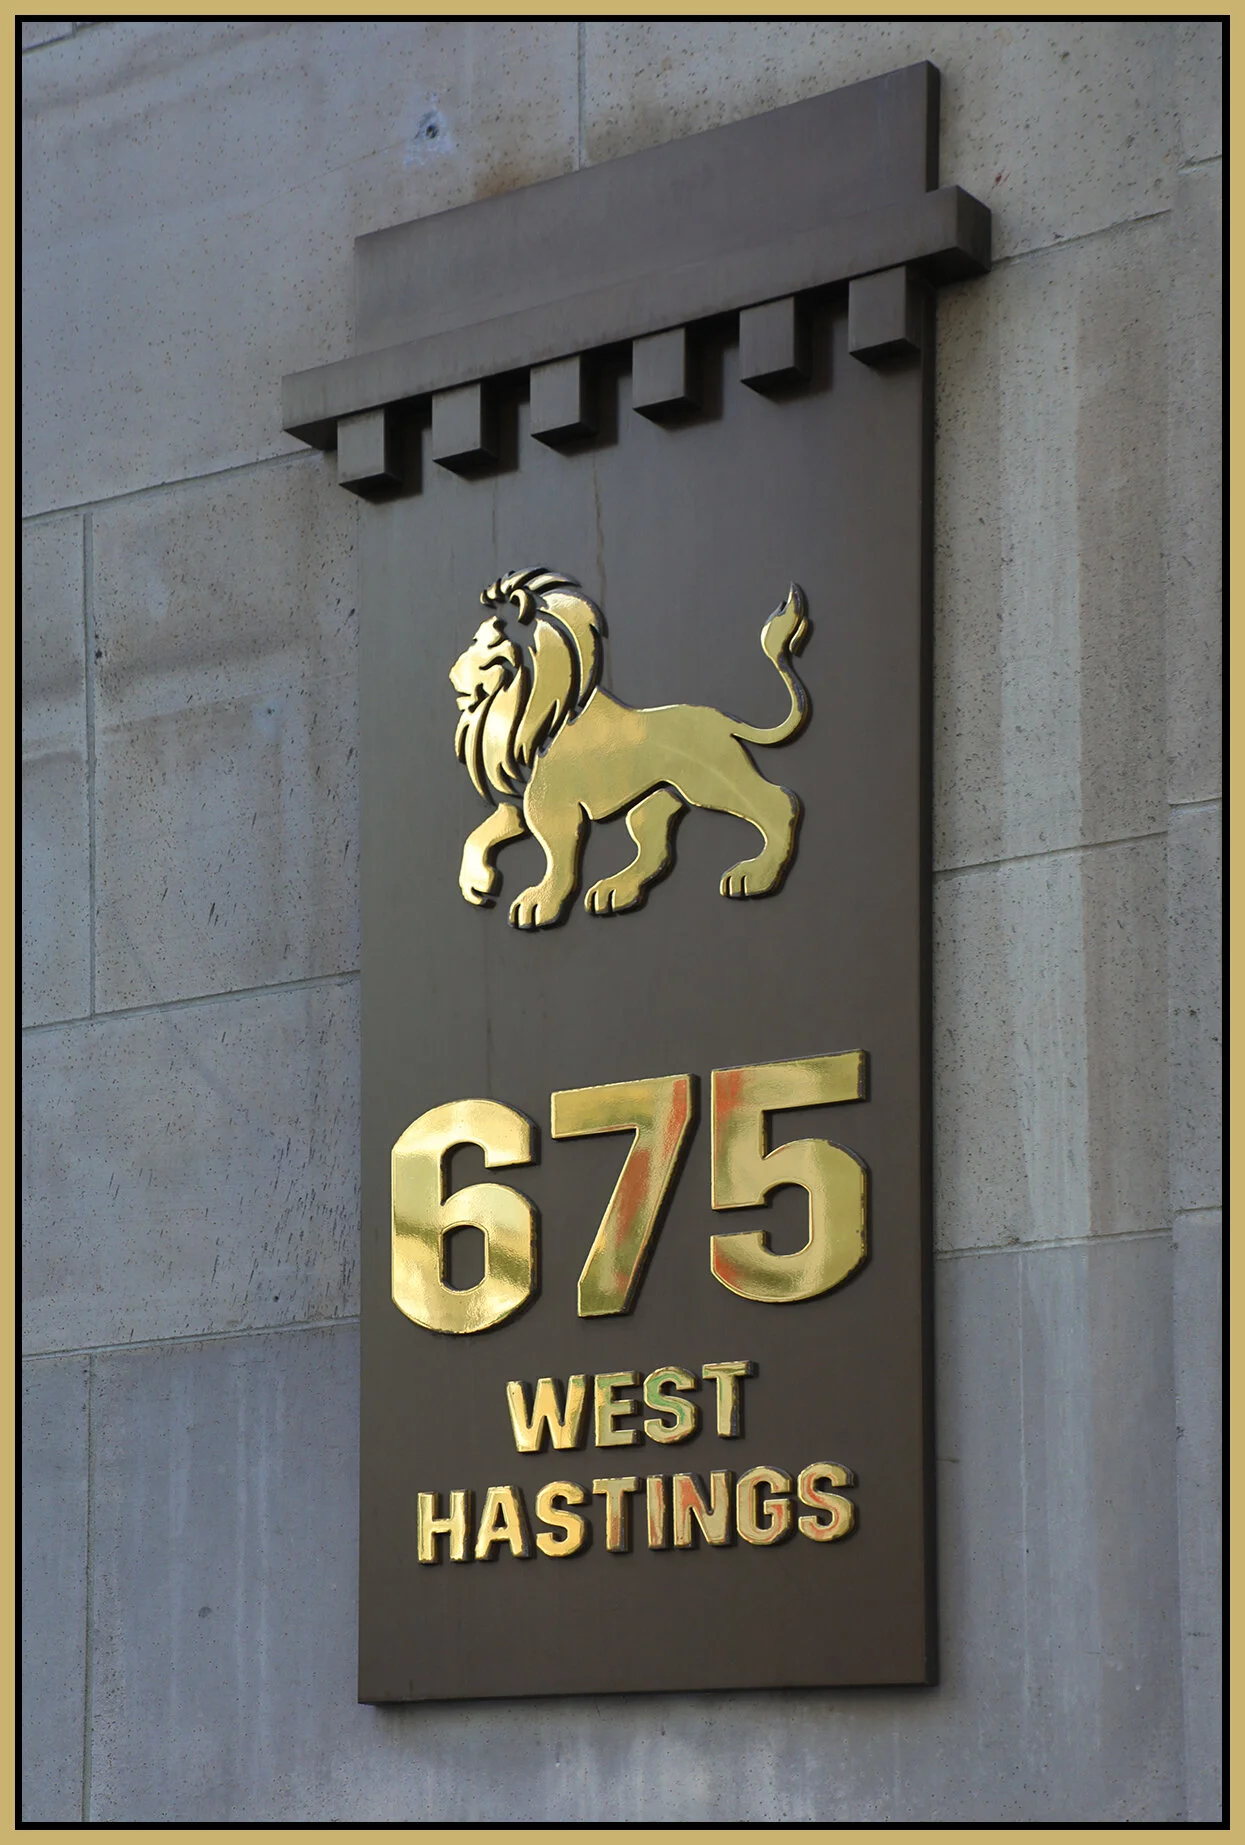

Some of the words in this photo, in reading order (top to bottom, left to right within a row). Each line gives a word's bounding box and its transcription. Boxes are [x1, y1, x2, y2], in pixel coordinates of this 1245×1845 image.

[390, 1050, 869, 1335] 675
[505, 1360, 752, 1453] WEST
[416, 1461, 856, 1564] HASTINGS
